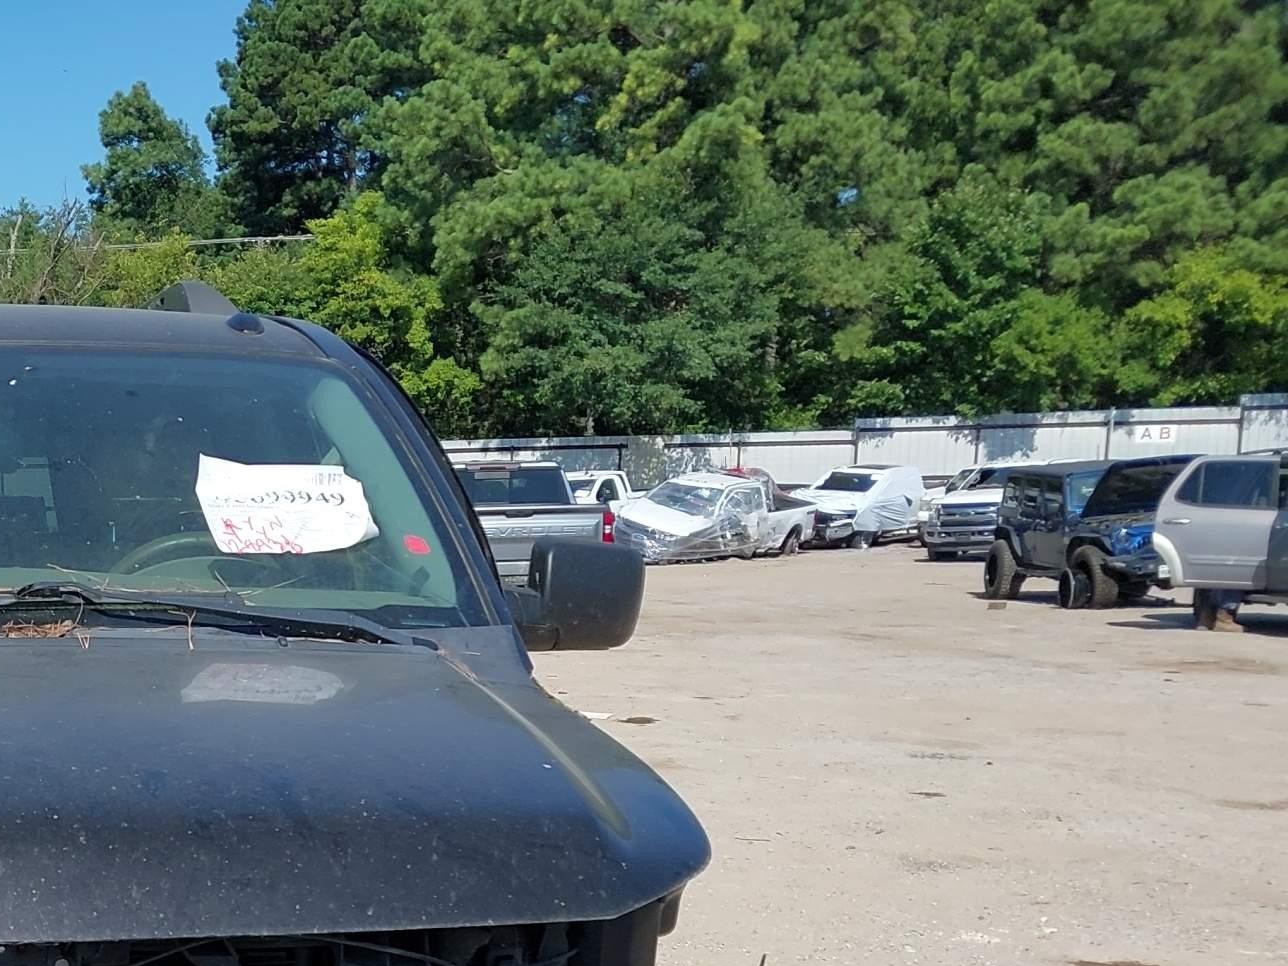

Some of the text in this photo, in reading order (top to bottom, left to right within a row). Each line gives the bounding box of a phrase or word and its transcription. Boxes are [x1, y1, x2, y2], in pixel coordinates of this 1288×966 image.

[1140, 427, 1171, 440] A B
[483, 526, 593, 537] EVROLET
